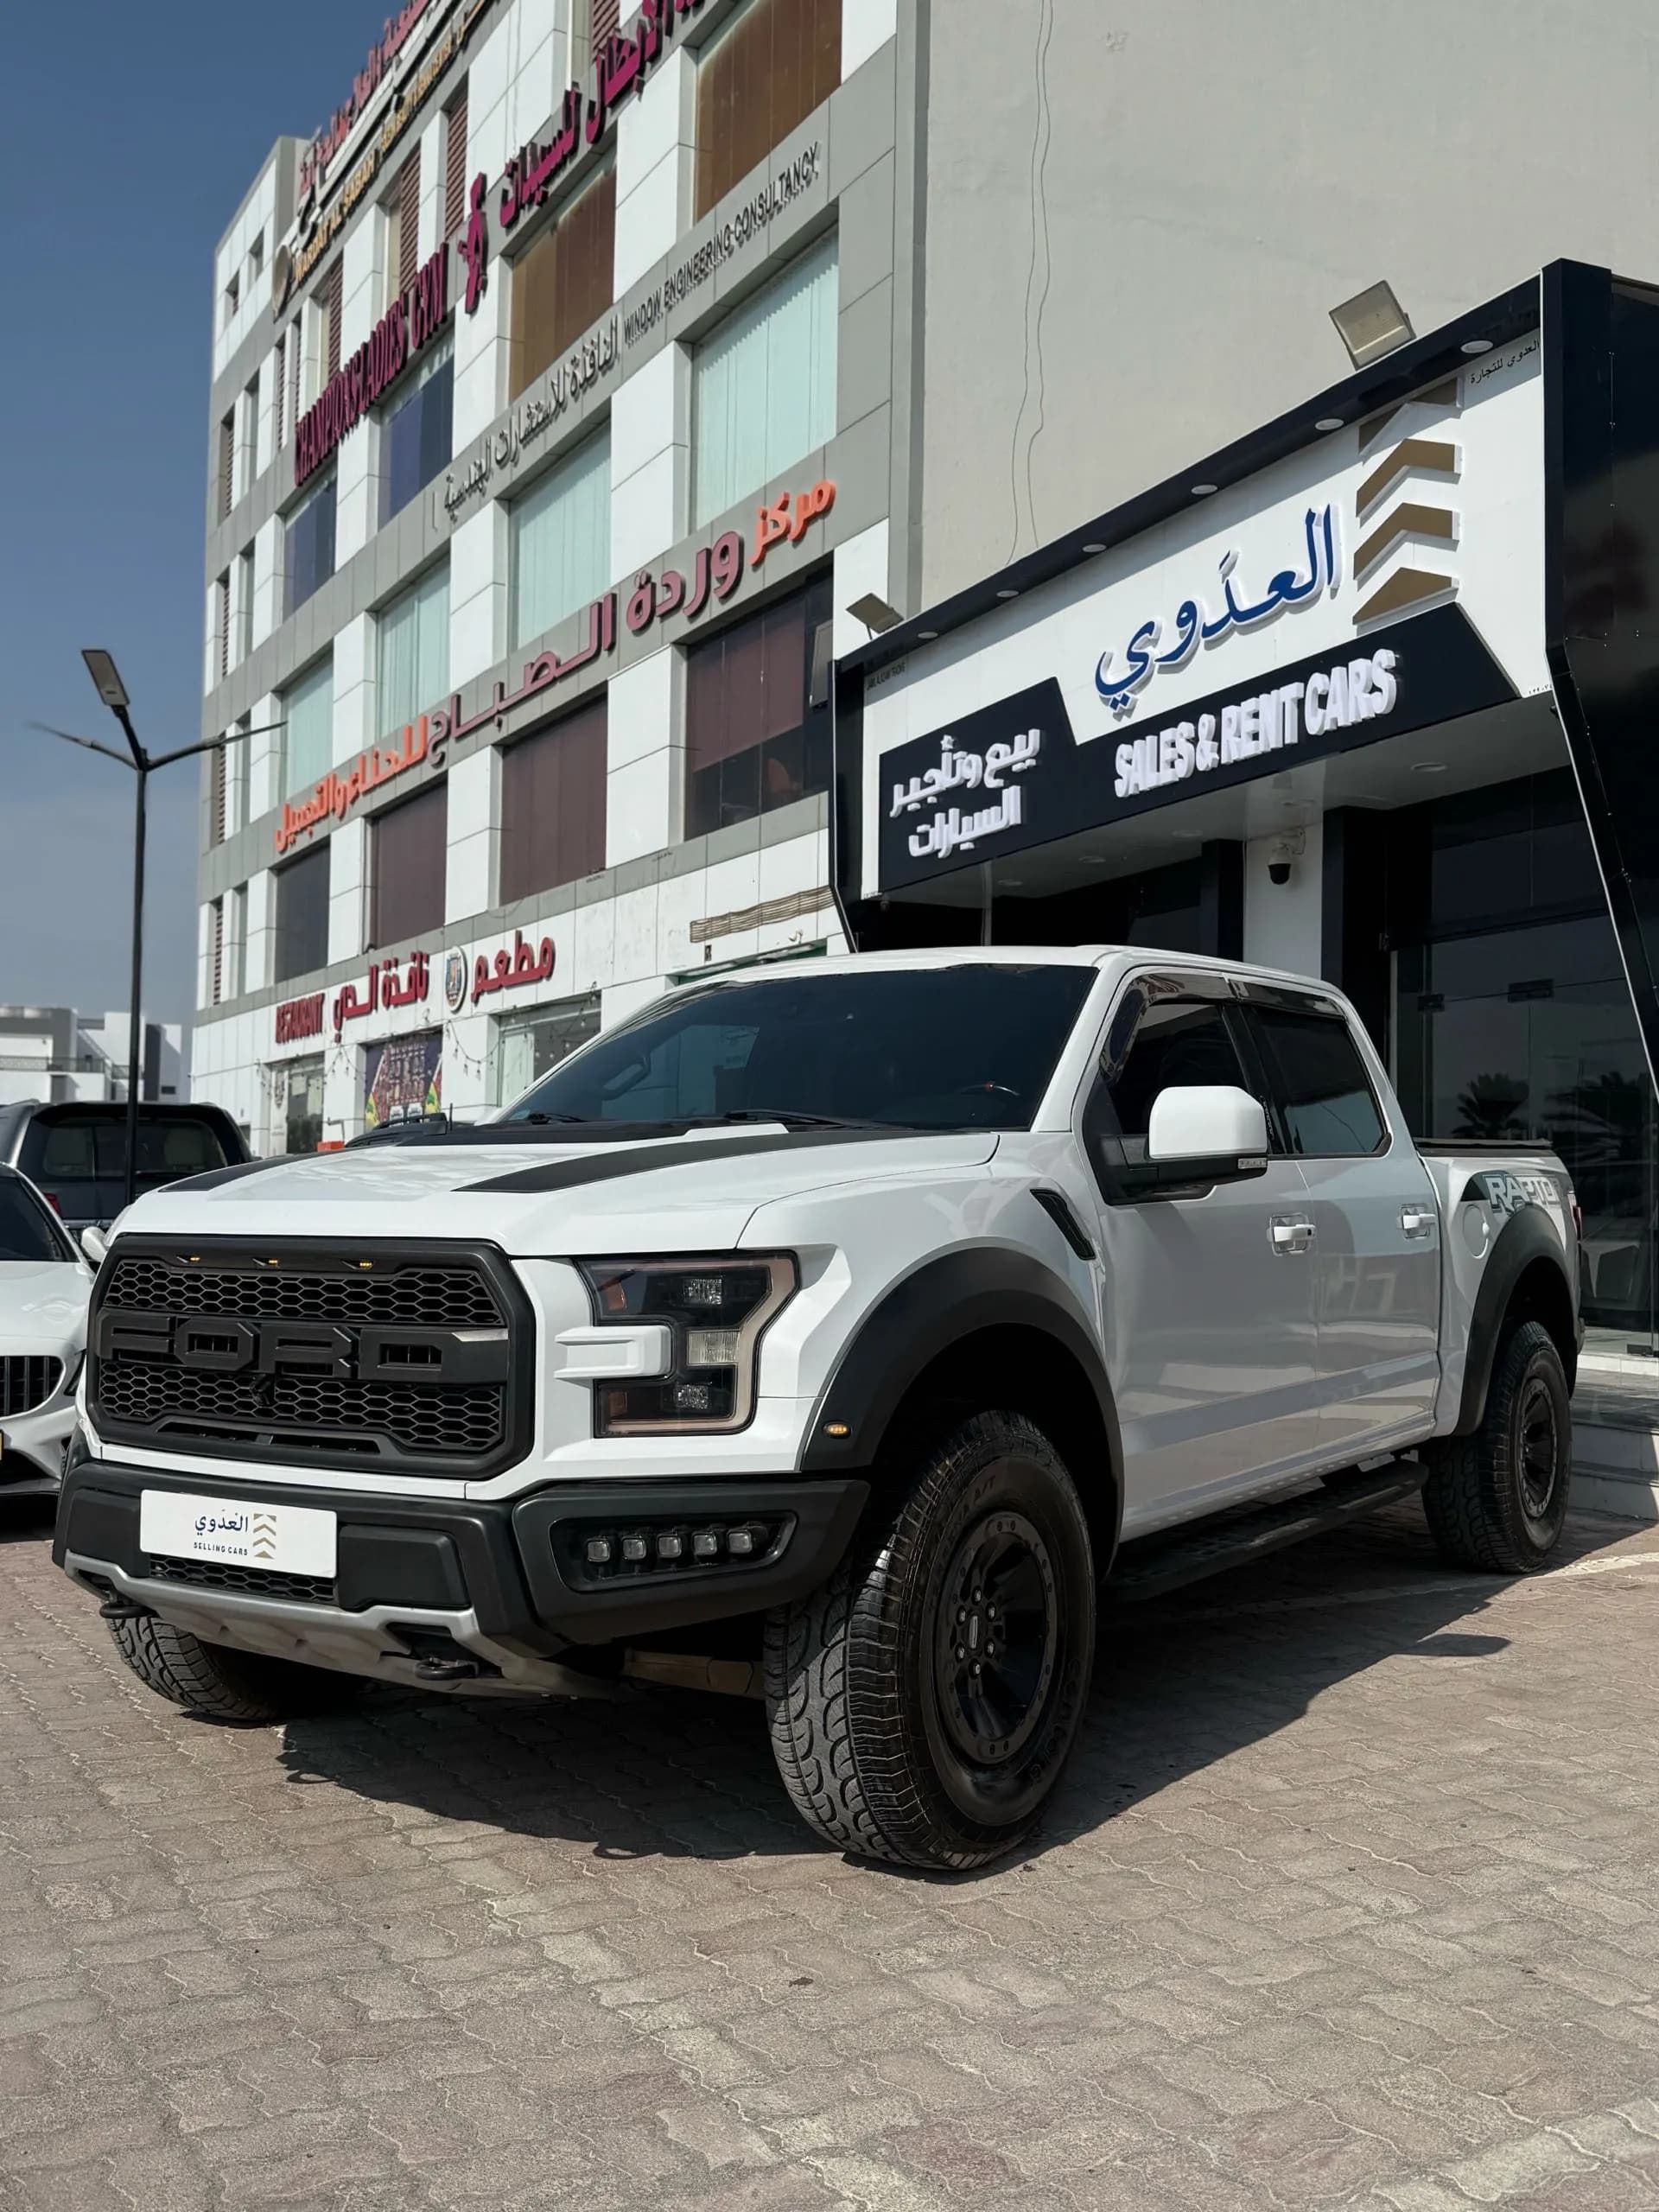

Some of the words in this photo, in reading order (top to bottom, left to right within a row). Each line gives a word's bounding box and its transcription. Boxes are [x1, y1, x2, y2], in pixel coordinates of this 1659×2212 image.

[624, 288, 661, 342] WINDOW
[734, 141, 818, 242] CONSULTANCY
[411, 243, 446, 347] GYM
[570, 315, 619, 396] النافذة
[1471, 358, 1503, 384] للتجارة
[444, 436, 492, 520] الهندسية
[748, 480, 836, 565] مركز
[626, 531, 741, 631] وردة
[428, 593, 615, 765] الصباح
[346, 715, 429, 802] للحناء
[984, 729, 1040, 788] بيع
[1115, 721, 1195, 798] SALES
[1221, 683, 1304, 764] RENT
[1305, 648, 1396, 735] CARS
[275, 773, 346, 851] والتجميل
[890, 735, 982, 817] وتأجير
[908, 785, 1021, 858] السيارات
[334, 964, 378, 1042] الحي
[381, 952, 429, 1007] نافذة
[471, 930, 555, 1002] مطعم
[96, 1308, 488, 1384] FORD
[194, 1541, 226, 1553] SELLING
[228, 1547, 248, 1556] CARS
